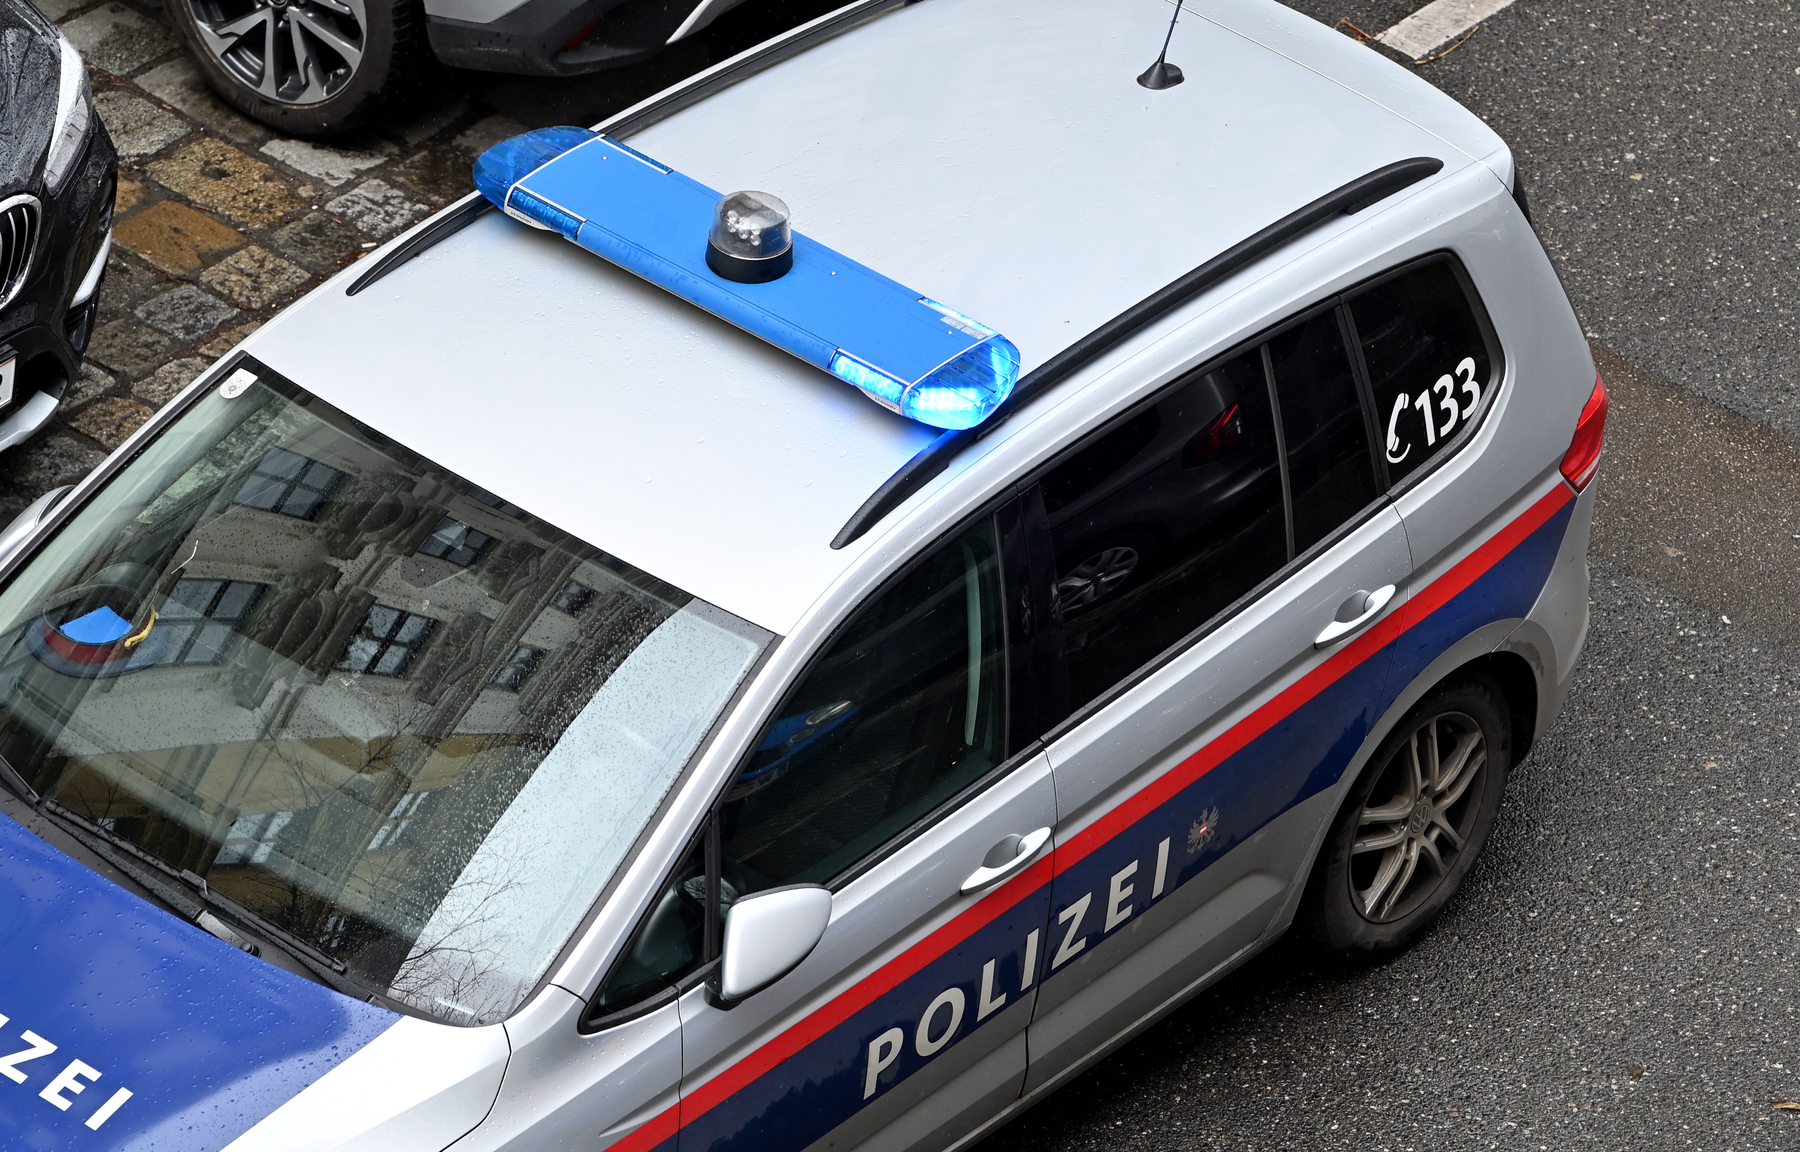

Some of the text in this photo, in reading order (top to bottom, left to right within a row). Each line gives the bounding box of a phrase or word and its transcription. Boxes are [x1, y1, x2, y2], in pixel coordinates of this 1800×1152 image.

[1414, 356, 1480, 447] 133
[863, 836, 1171, 1101] POLIZEI
[0, 1013, 134, 1131] ZEI
